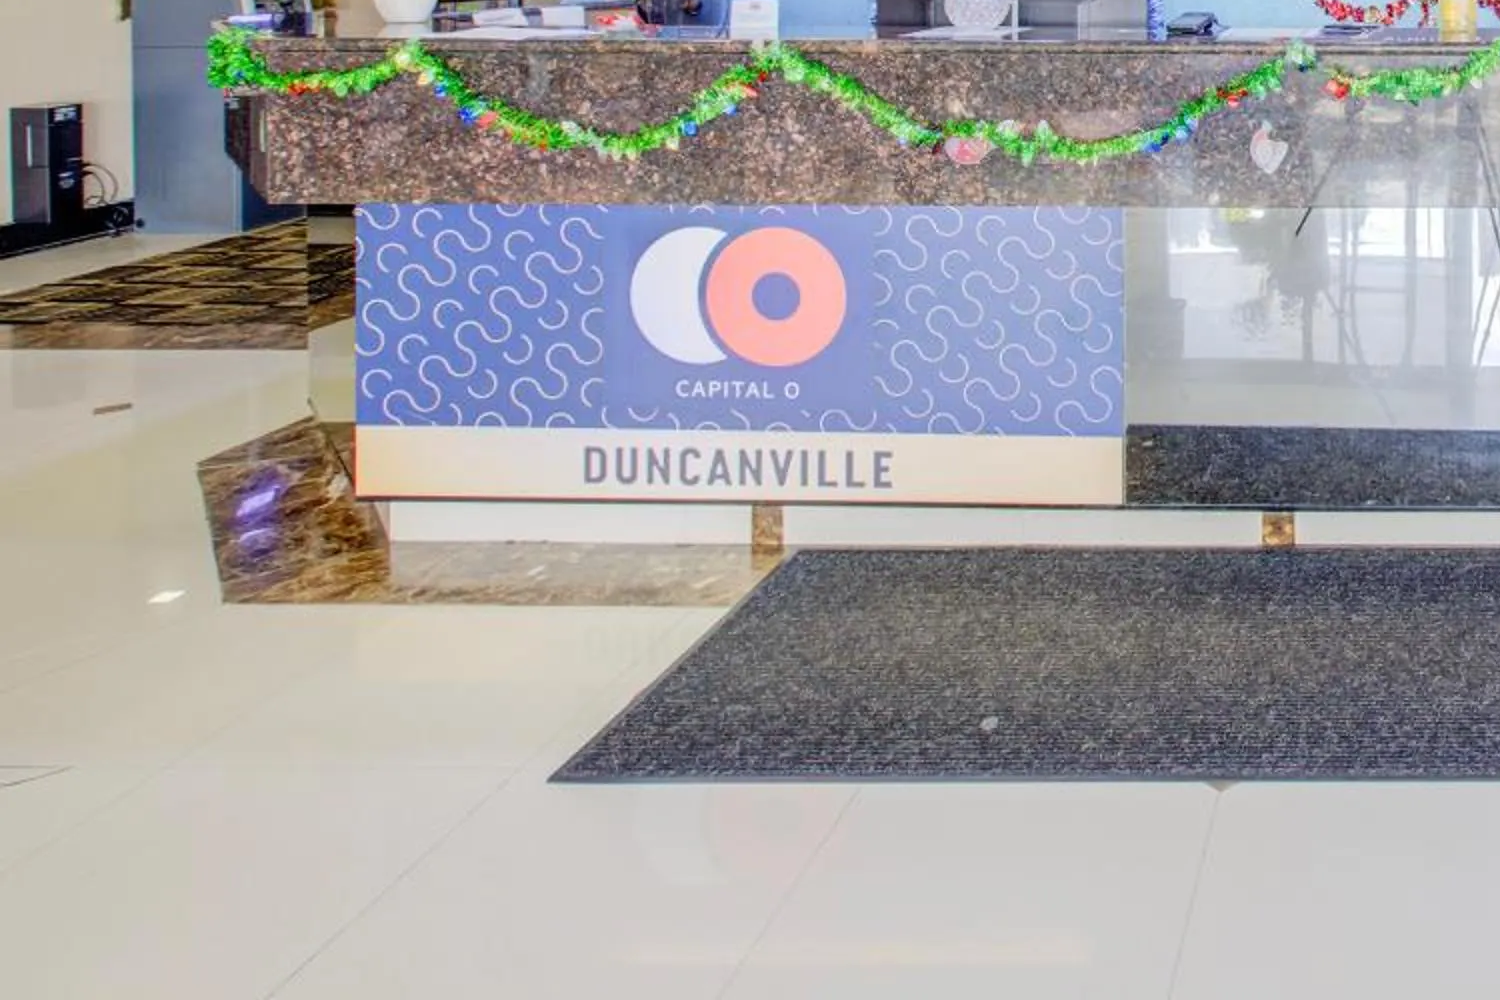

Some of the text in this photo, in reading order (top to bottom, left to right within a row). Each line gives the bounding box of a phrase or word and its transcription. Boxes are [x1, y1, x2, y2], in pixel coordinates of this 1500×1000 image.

[675, 379, 800, 400] CAPITAL O
[583, 445, 893, 489] DUNCANVILLE
